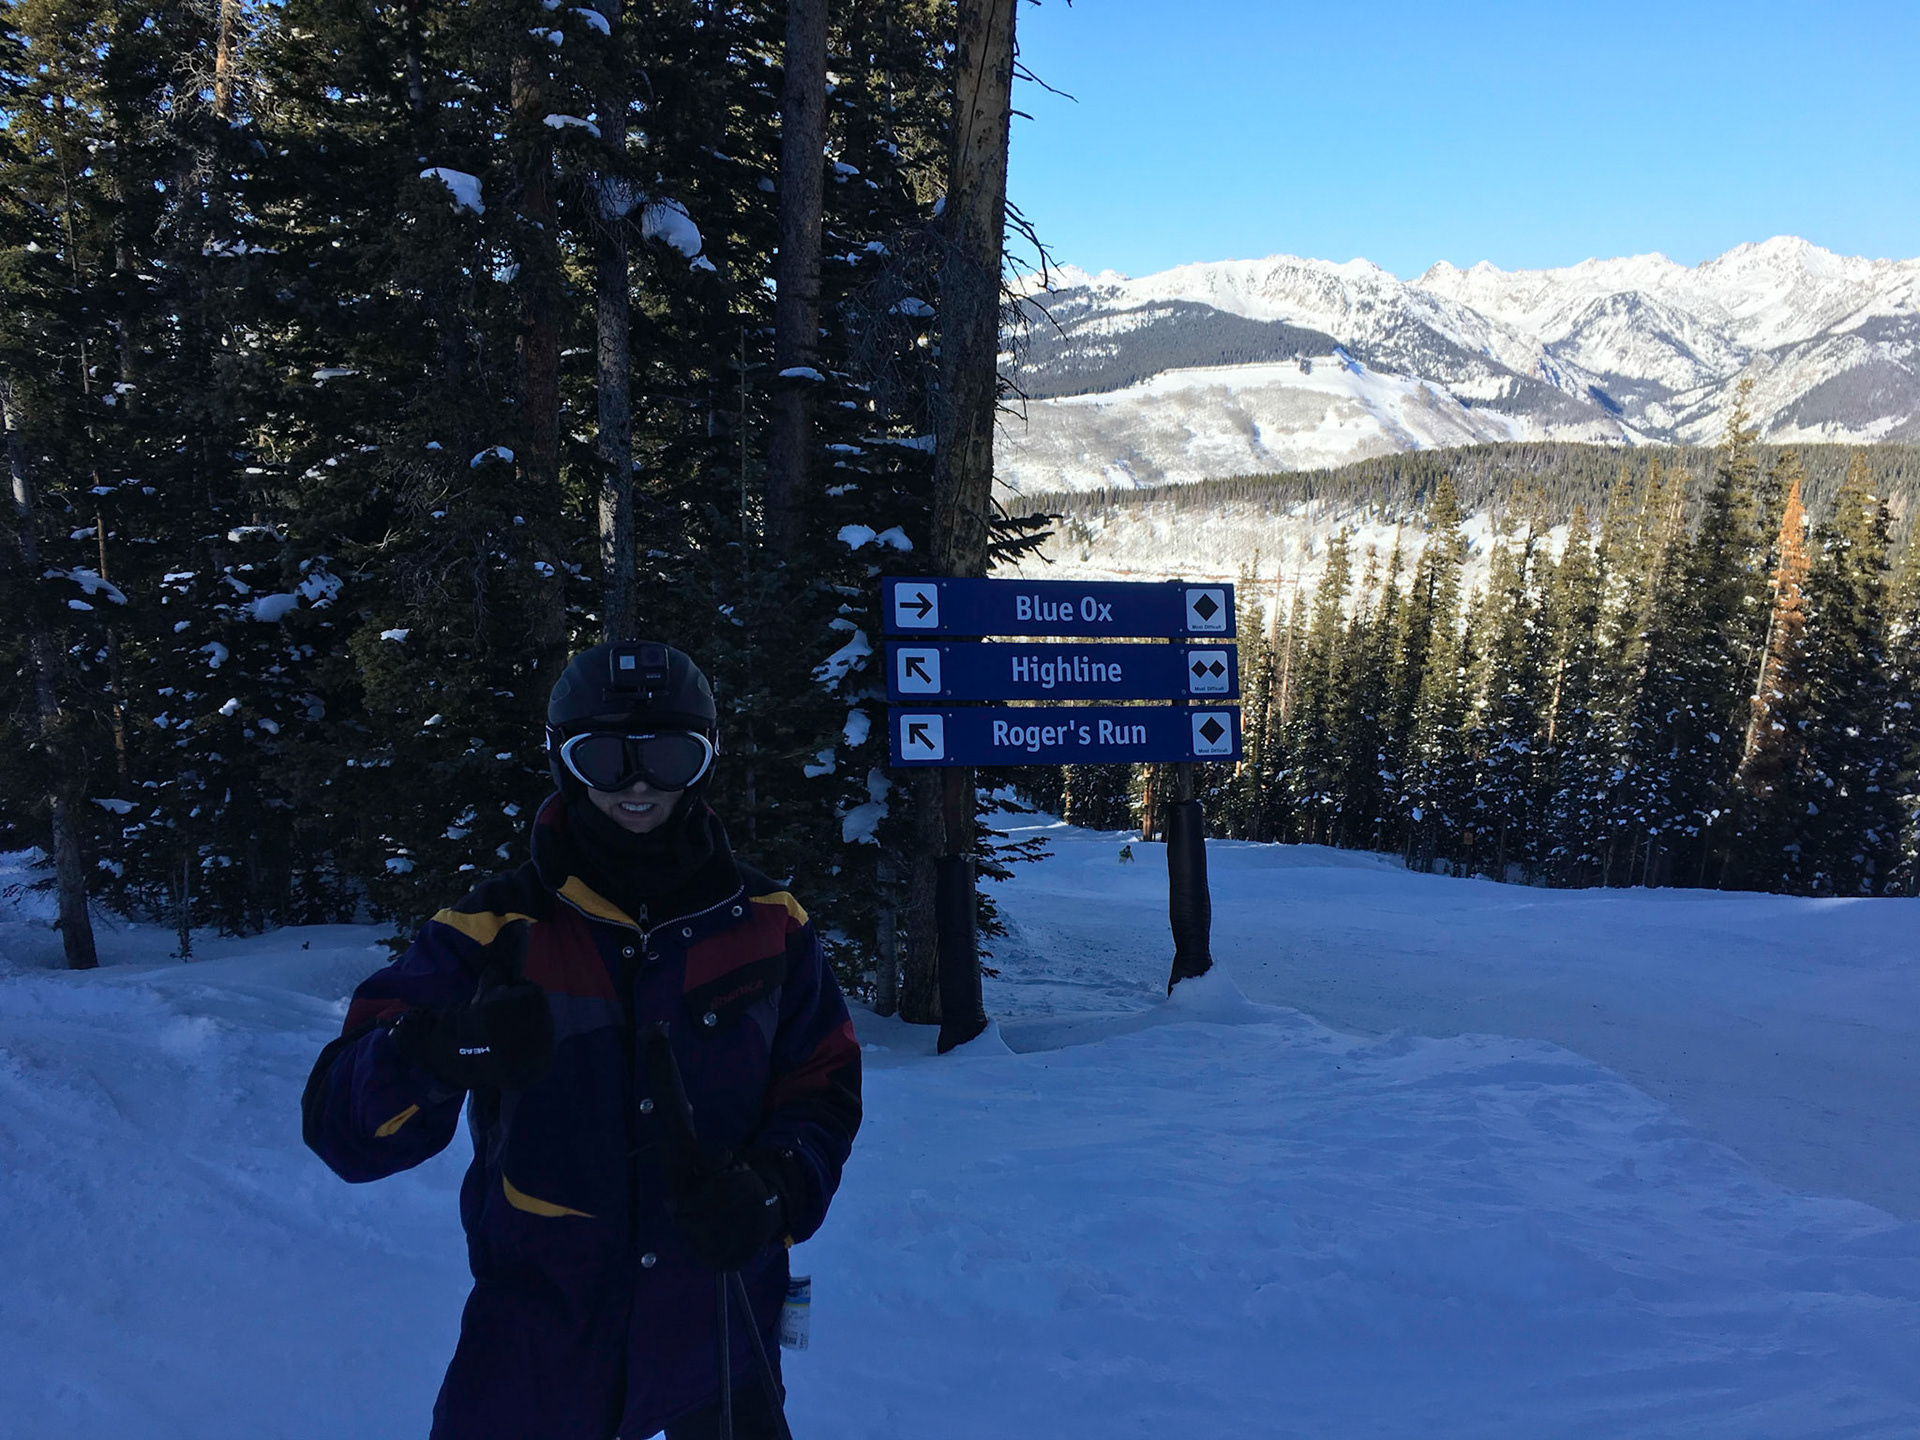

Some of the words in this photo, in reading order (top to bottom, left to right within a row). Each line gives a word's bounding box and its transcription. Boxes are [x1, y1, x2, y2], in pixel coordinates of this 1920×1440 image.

[1016, 594, 1074, 622] Blue
[1080, 596, 1113, 622] Ox
[1012, 655, 1122, 689] Highline
[993, 720, 1091, 752] Roger's
[1098, 719, 1146, 745] Run
